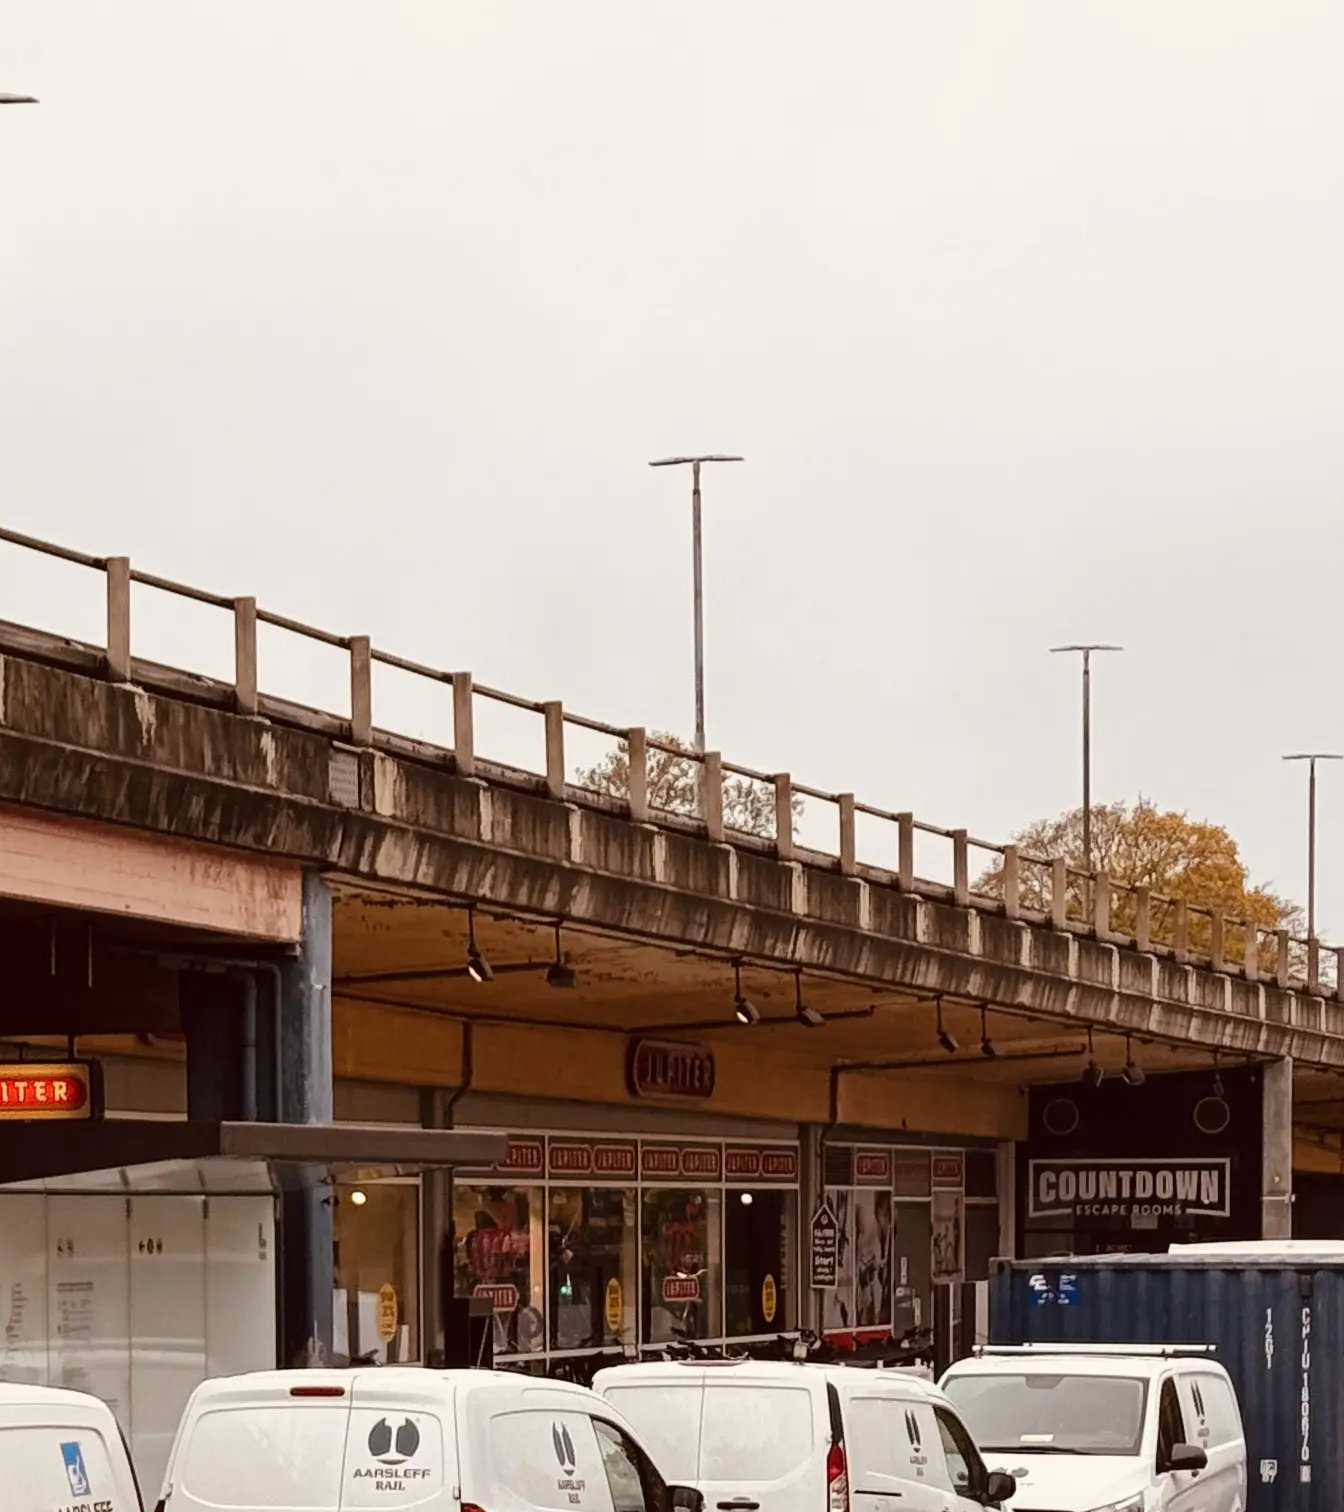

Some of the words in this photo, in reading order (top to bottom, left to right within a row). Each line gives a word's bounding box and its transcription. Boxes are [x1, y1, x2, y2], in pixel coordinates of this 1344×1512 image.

[646, 1053, 711, 1089] JUPITER
[1039, 1169, 1220, 1205] COUNTDOWN
[1076, 1204, 1126, 1216] ESCAPE
[1132, 1202, 1182, 1216] ROOMS
[352, 1467, 432, 1480] AARSLEFF
[375, 1480, 406, 1492] RAIL
